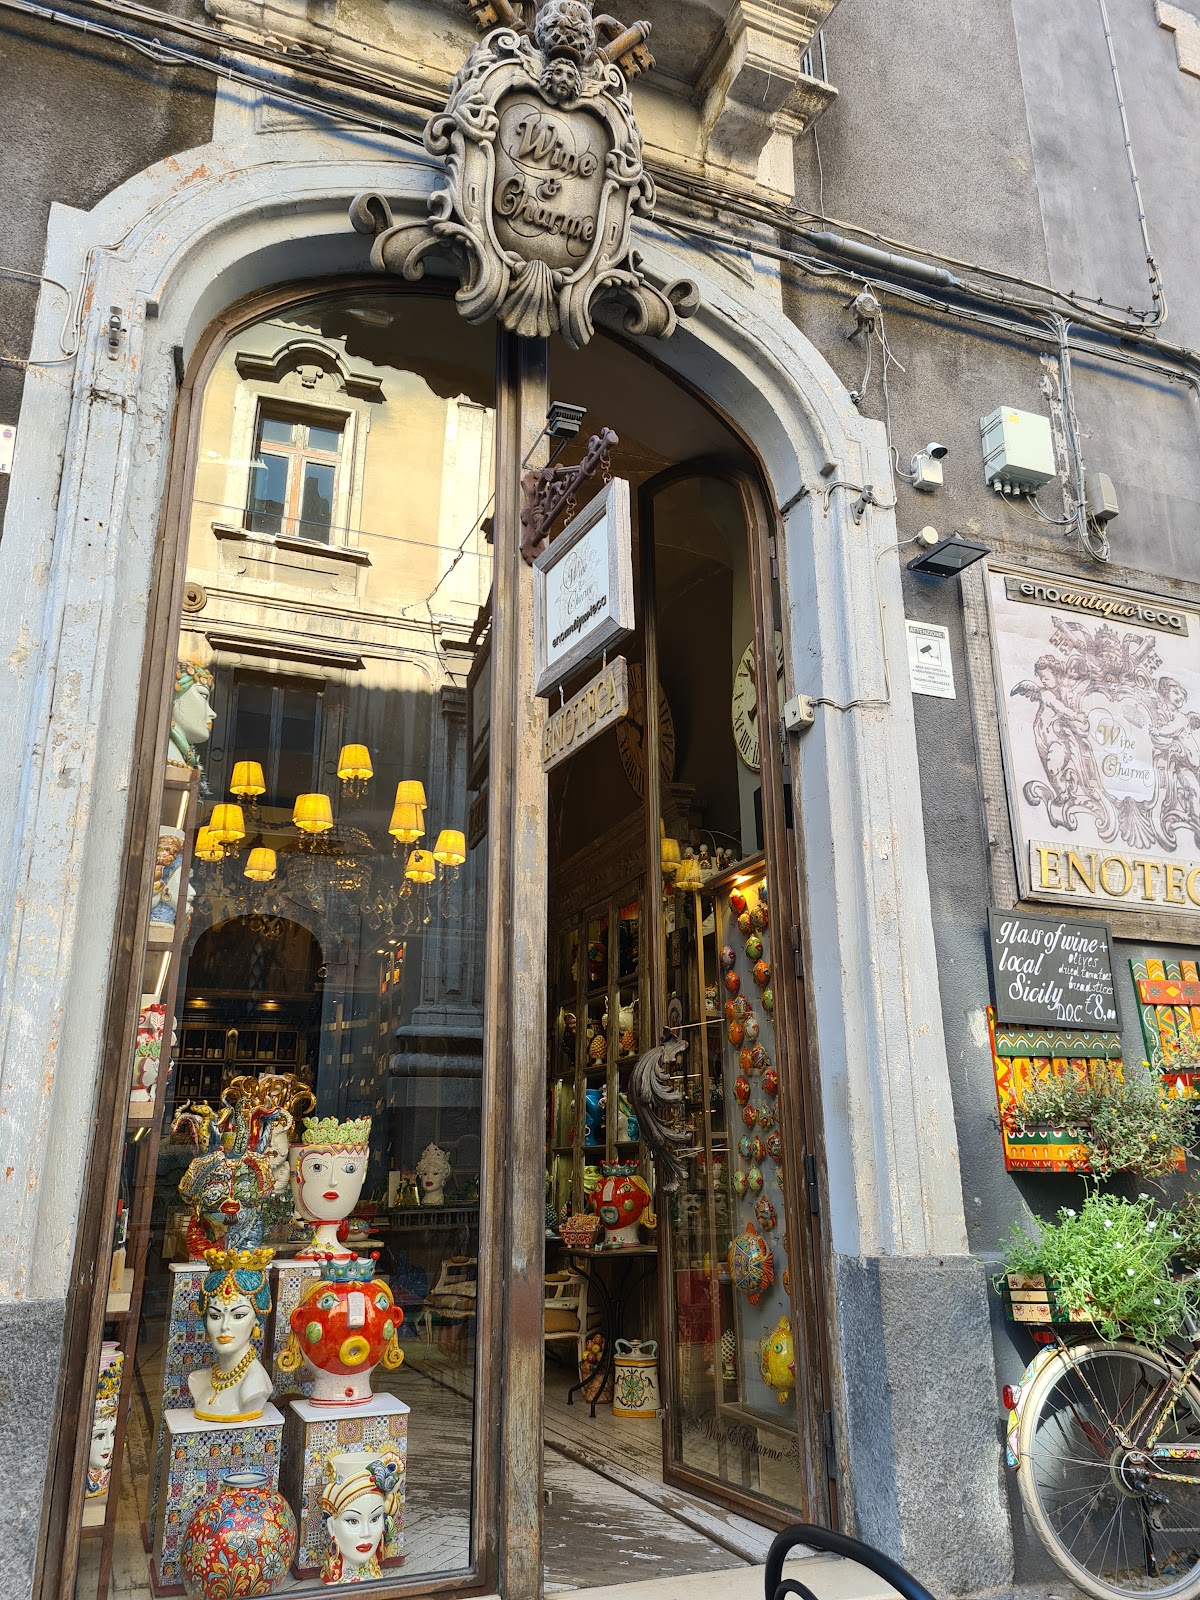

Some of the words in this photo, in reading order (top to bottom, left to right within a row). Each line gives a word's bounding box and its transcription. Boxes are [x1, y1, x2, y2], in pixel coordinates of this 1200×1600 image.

[515, 121, 598, 178] Wine
[539, 178, 562, 199] &
[495, 173, 595, 242] Charme
[1020, 582, 1183, 629] enoantiquoteca
[543, 671, 620, 764] ENOTECA
[1097, 724, 1136, 750] Wine
[1102, 754, 1150, 780] Charme
[996, 921, 1044, 947] glass
[1044, 923, 1066, 954] of
[1061, 931, 1098, 953] wine
[999, 947, 1044, 976] local
[1068, 952, 1099, 968] olives
[1008, 972, 1064, 1011] Sicily
[741, 1426, 784, 1462] Charme
